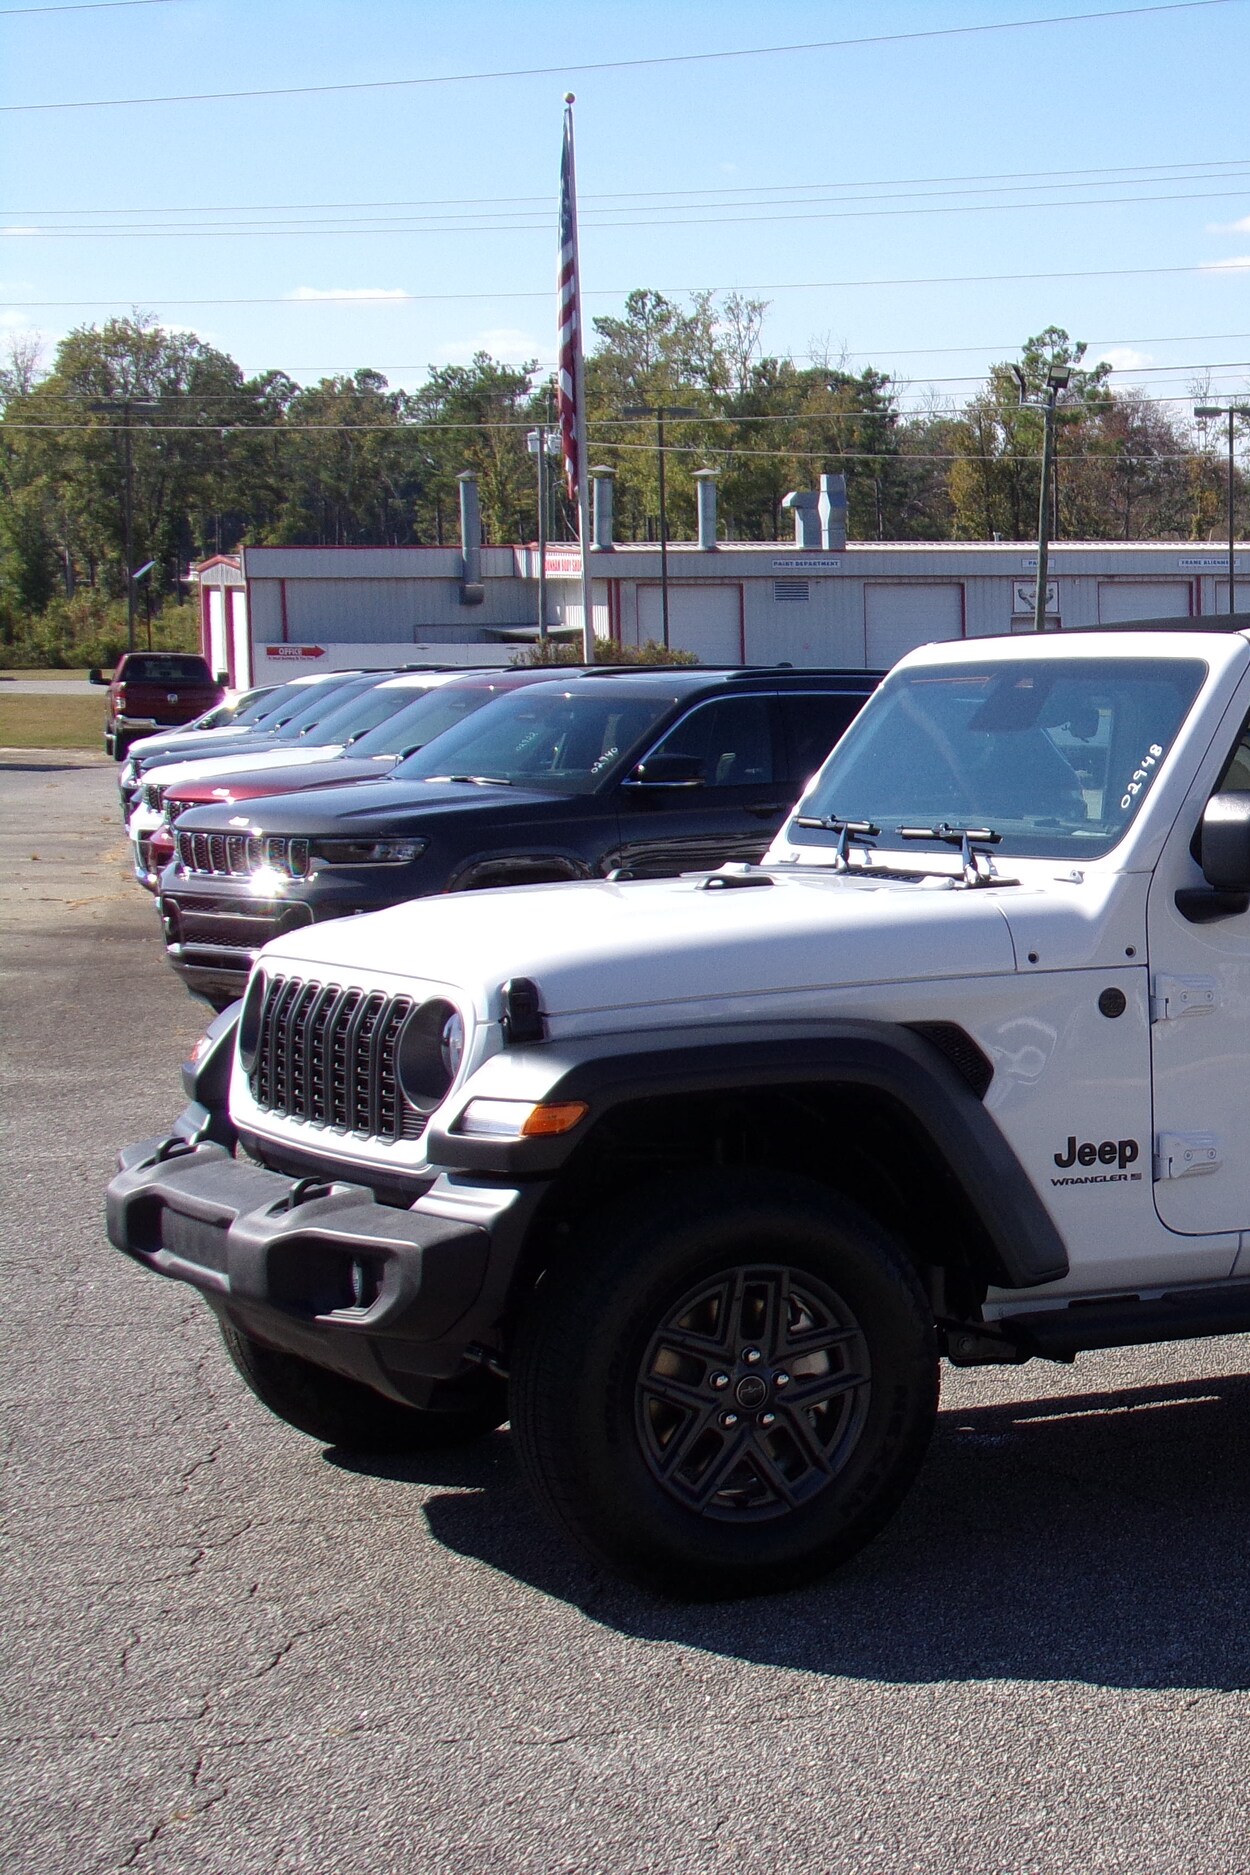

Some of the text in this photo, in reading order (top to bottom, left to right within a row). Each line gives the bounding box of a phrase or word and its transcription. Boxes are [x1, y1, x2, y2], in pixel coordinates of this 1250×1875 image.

[278, 647, 303, 655] OFFICE
[591, 747, 618, 773] 02940
[1121, 744, 1163, 808] 02948
[1054, 1136, 1139, 1169] Jeep
[1050, 1173, 1128, 1187] WRANGLER
